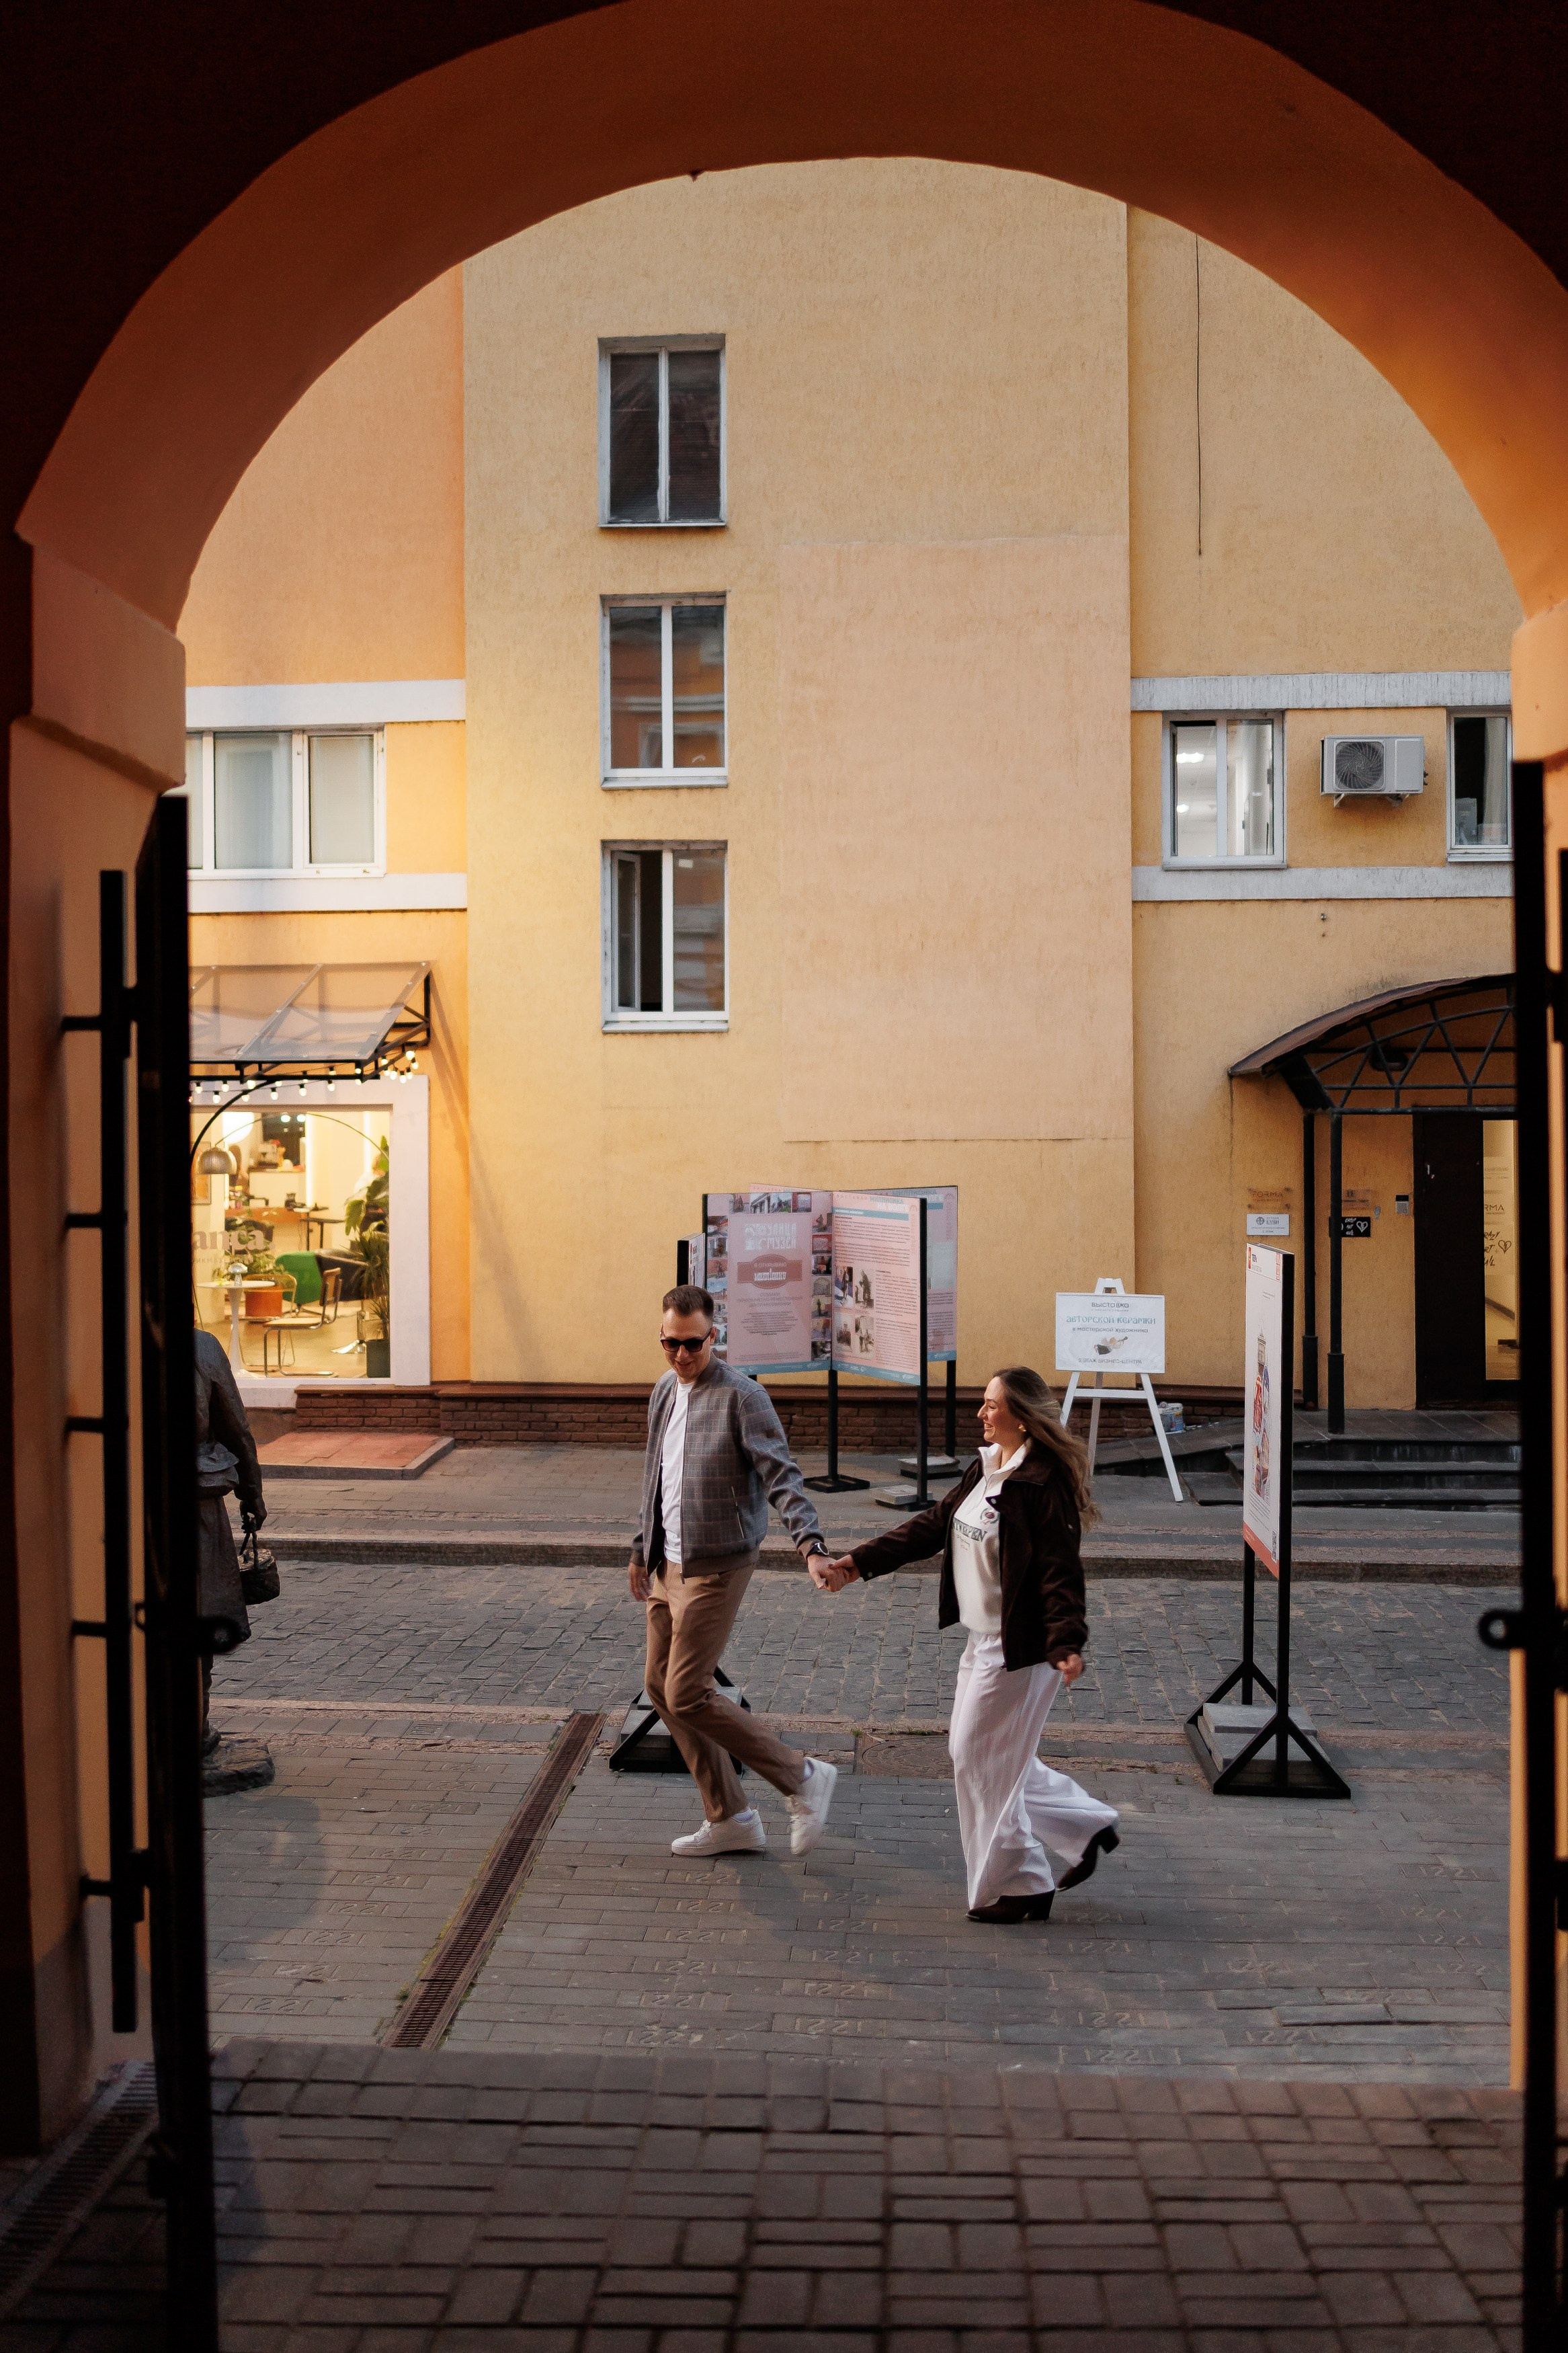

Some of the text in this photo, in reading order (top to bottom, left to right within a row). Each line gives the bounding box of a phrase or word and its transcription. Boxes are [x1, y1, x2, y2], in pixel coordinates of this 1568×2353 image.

[1484, 1230, 1500, 1240] RAZY
[352, 1873, 412, 1886] 1221
[684, 1872, 741, 1883] 1221
[329, 1902, 389, 1915] 1221
[677, 1900, 735, 1913] 1221
[817, 1918, 877, 1931] 1221
[302, 1931, 366, 1944] 1221
[665, 1929, 726, 1942] 1221
[813, 1950, 873, 1964] 1221
[654, 1960, 717, 1975] 1221
[241, 1997, 314, 2012] 1221
[795, 2018, 862, 2034] 1221
